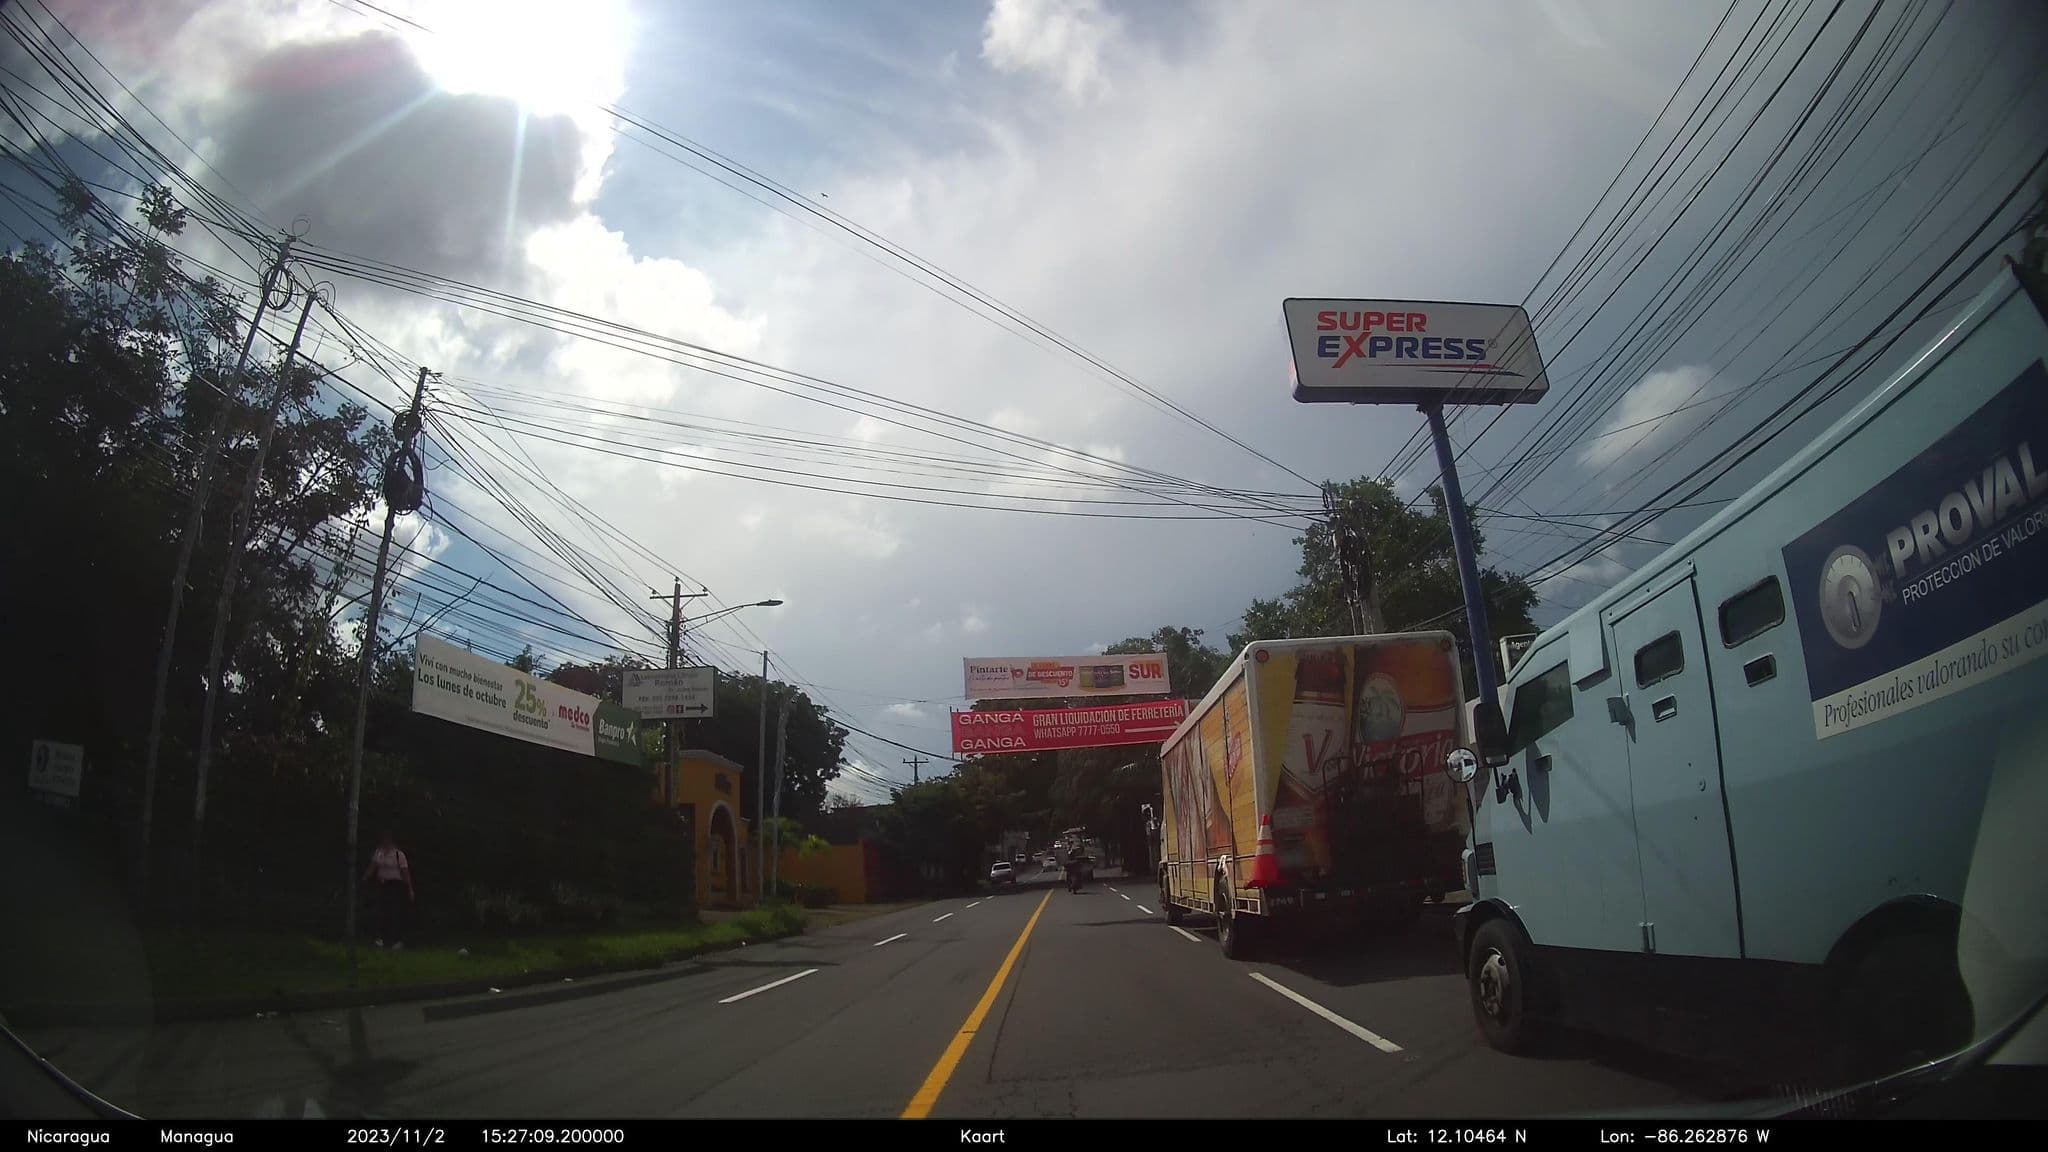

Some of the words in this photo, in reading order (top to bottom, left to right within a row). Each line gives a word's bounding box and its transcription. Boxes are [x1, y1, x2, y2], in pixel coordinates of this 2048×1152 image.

[1316, 311, 1427, 332] SUPER
[1317, 332, 1487, 368] EXPRESS
[1886, 441, 2048, 579] PROVAL
[1902, 553, 1982, 605] PROTECCION
[1982, 538, 2003, 562] DE
[435, 660, 449, 673] con
[449, 665, 473, 681] mucho
[472, 672, 504, 692] bienestar
[969, 665, 1009, 674] Pintarte
[1028, 670, 1037, 678] DE
[1037, 670, 1073, 678] DESCUENTO
[1128, 663, 1162, 680] SUR
[417, 668, 435, 686] Los
[437, 674, 462, 695] lunes
[462, 683, 474, 698] de
[475, 691, 507, 708] octubre
[1823, 676, 1914, 729] Profesionales
[1915, 638, 1999, 694] valorando
[2001, 633, 2020, 657] su
[513, 678, 547, 717] 25%
[558, 704, 591, 725] medco
[959, 713, 1025, 726] GANGA
[1033, 713, 1059, 727] GRAN
[1059, 710, 1116, 726] LIQUIDACION
[1117, 709, 1130, 722] DE
[598, 718, 626, 741] Banpro
[1034, 726, 1077, 740] WHATSAPP
[960, 736, 1026, 750] GANGA
